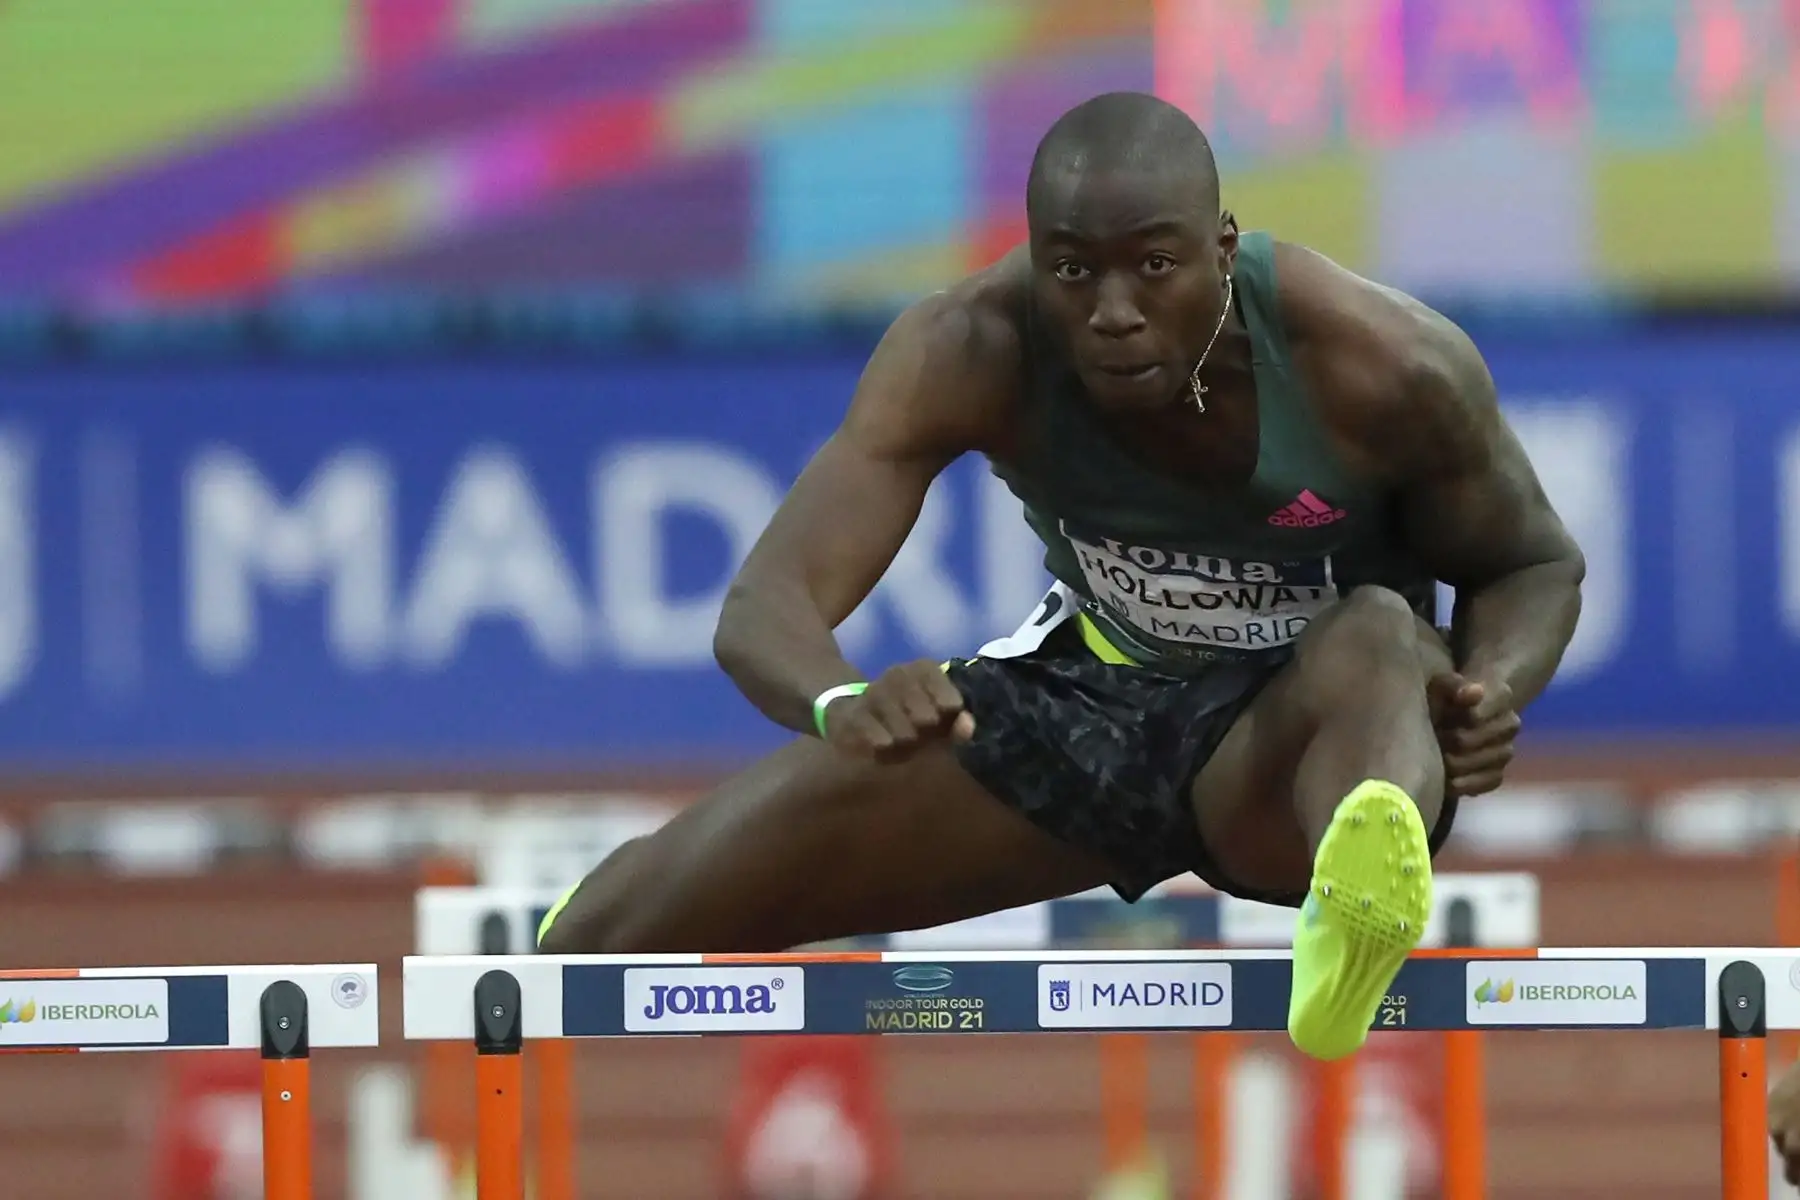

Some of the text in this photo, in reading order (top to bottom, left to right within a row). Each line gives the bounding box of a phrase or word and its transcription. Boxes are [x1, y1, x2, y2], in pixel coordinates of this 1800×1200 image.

[1267, 509, 1347, 528] adidas
[1150, 616, 1310, 645] MADRID
[1092, 982, 1224, 1008] MADRID
[1382, 995, 1407, 1006] OLD
[1519, 984, 1638, 1001] IBERDROLA
[41, 1003, 160, 1021] IBERDROLA
[865, 998, 984, 1010] INDOOR TOUR GOLD
[865, 1011, 984, 1030] MADRID 21
[1382, 1007, 1406, 1025] 21
